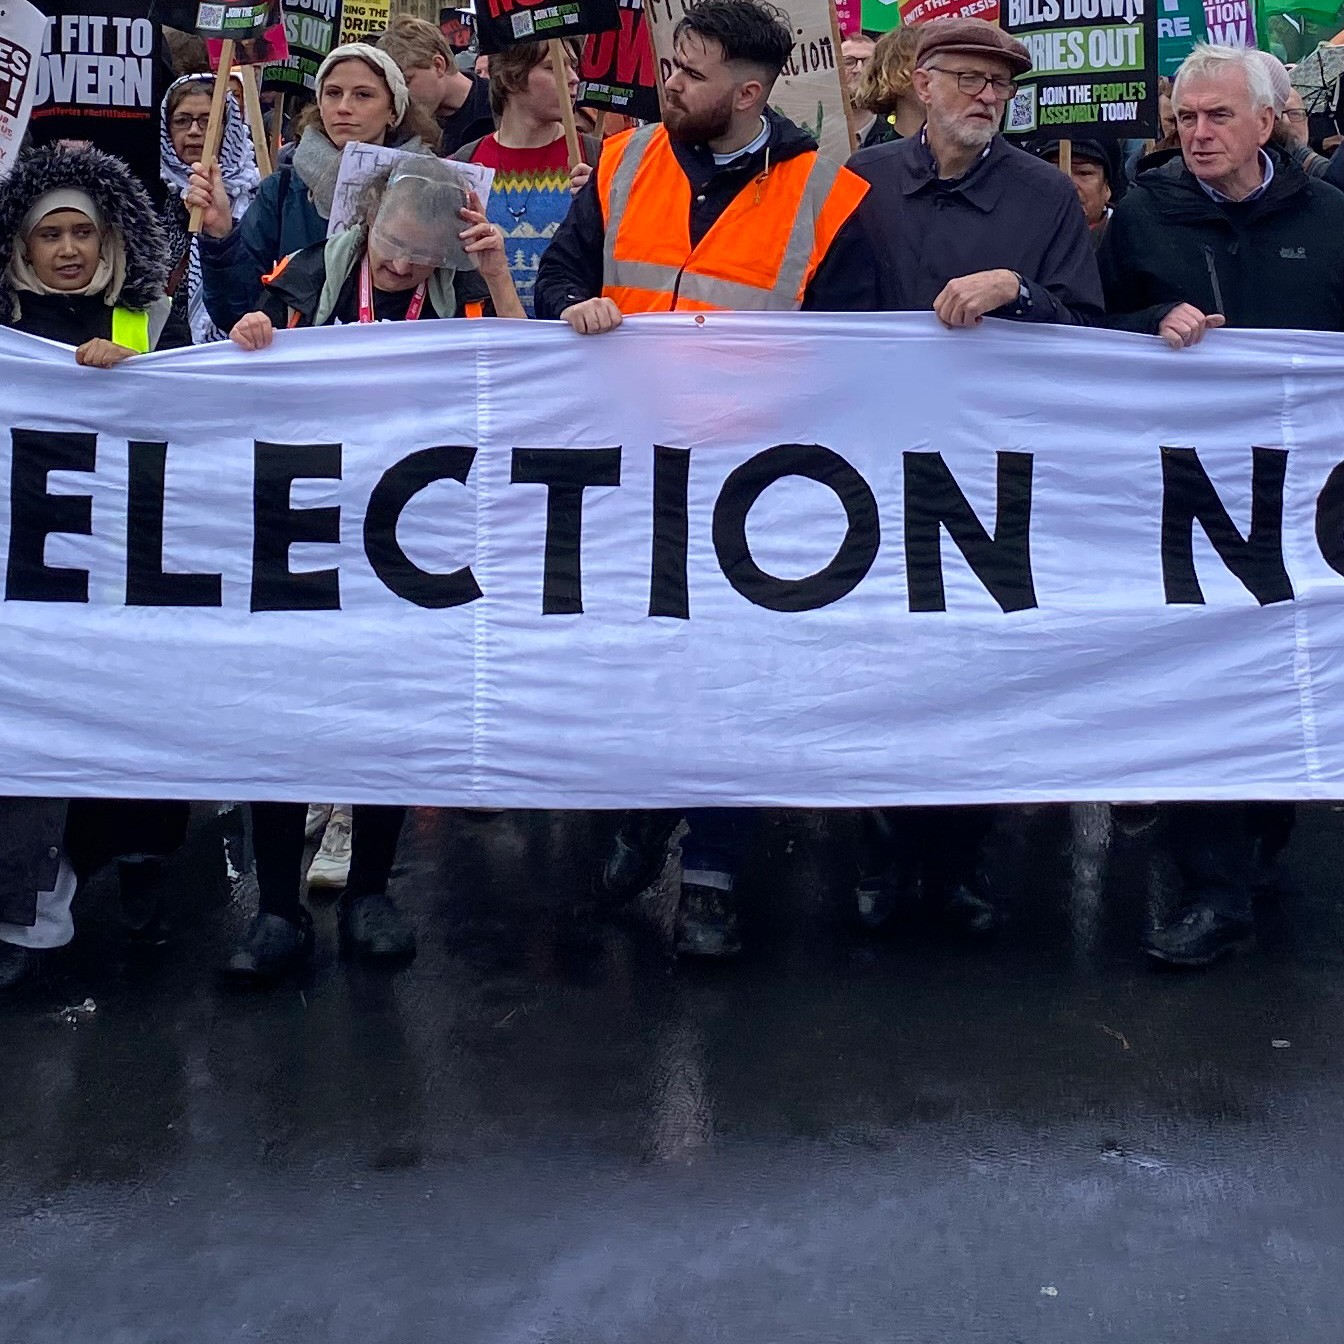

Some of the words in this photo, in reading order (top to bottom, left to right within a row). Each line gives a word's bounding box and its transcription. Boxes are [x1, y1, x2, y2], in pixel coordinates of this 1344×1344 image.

[369, 7, 388, 18] THE
[61, 15, 108, 54] FIT
[112, 17, 153, 56] TO
[301, 17, 331, 56] OUT
[1088, 27, 1140, 68] OUT
[32, 54, 153, 107] OVERN
[1040, 86, 1067, 106] JOIN
[1068, 84, 1092, 103] THE
[1092, 82, 1147, 102] PEOPLE'S
[1, 125, 13, 137] US
[1040, 104, 1100, 125] ASSEMBLY
[1101, 102, 1138, 121] TODAY
[3, 426, 1038, 619] ELECTION
